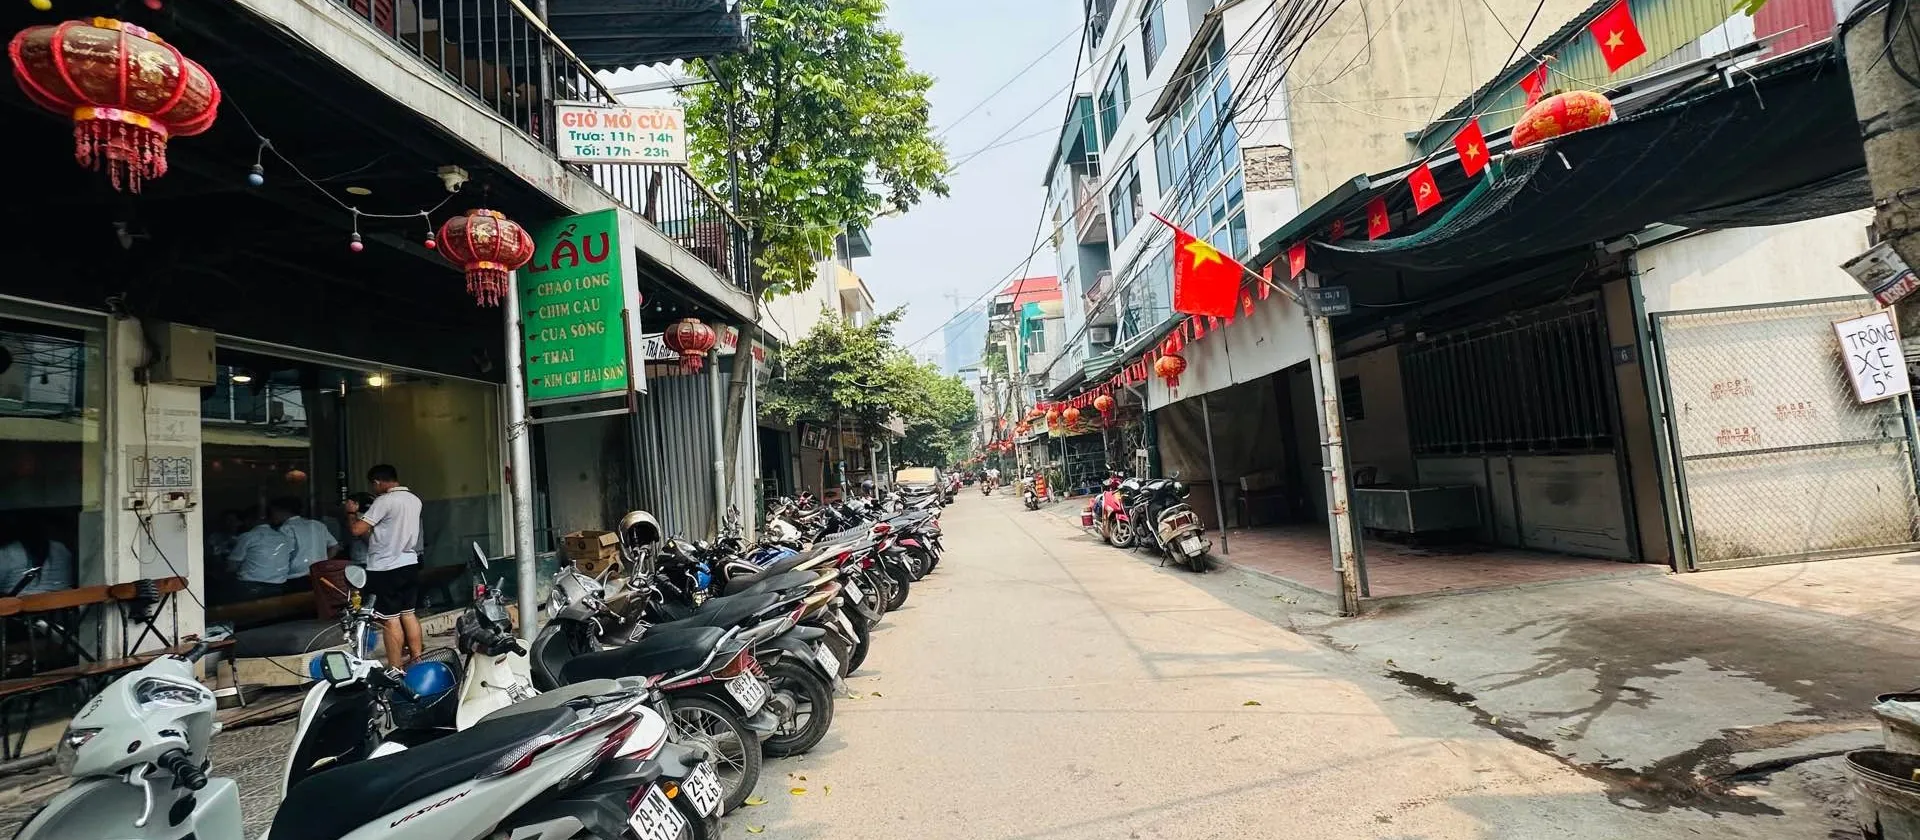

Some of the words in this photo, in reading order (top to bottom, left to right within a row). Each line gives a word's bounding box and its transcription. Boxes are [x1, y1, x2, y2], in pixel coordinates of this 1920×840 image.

[562, 109, 598, 128] GIỜ
[603, 108, 633, 129] MỞ
[637, 109, 678, 130] CỬA
[568, 130, 605, 142] Trưa:
[610, 131, 635, 142] 11h
[649, 132, 674, 143] 14h
[574, 143, 600, 156] Tối:
[606, 146, 631, 157] 17h
[644, 147, 670, 157] 23h
[527, 224, 610, 273] LẨU
[539, 303, 571, 319] CHIM
[541, 327, 567, 342] CUA
[1846, 325, 1896, 350] TRÔNG
[1853, 347, 1894, 376] XE
[543, 372, 563, 388] KIM
[390, 788, 472, 828] VISION
[650, 806, 684, 840] 17.31
